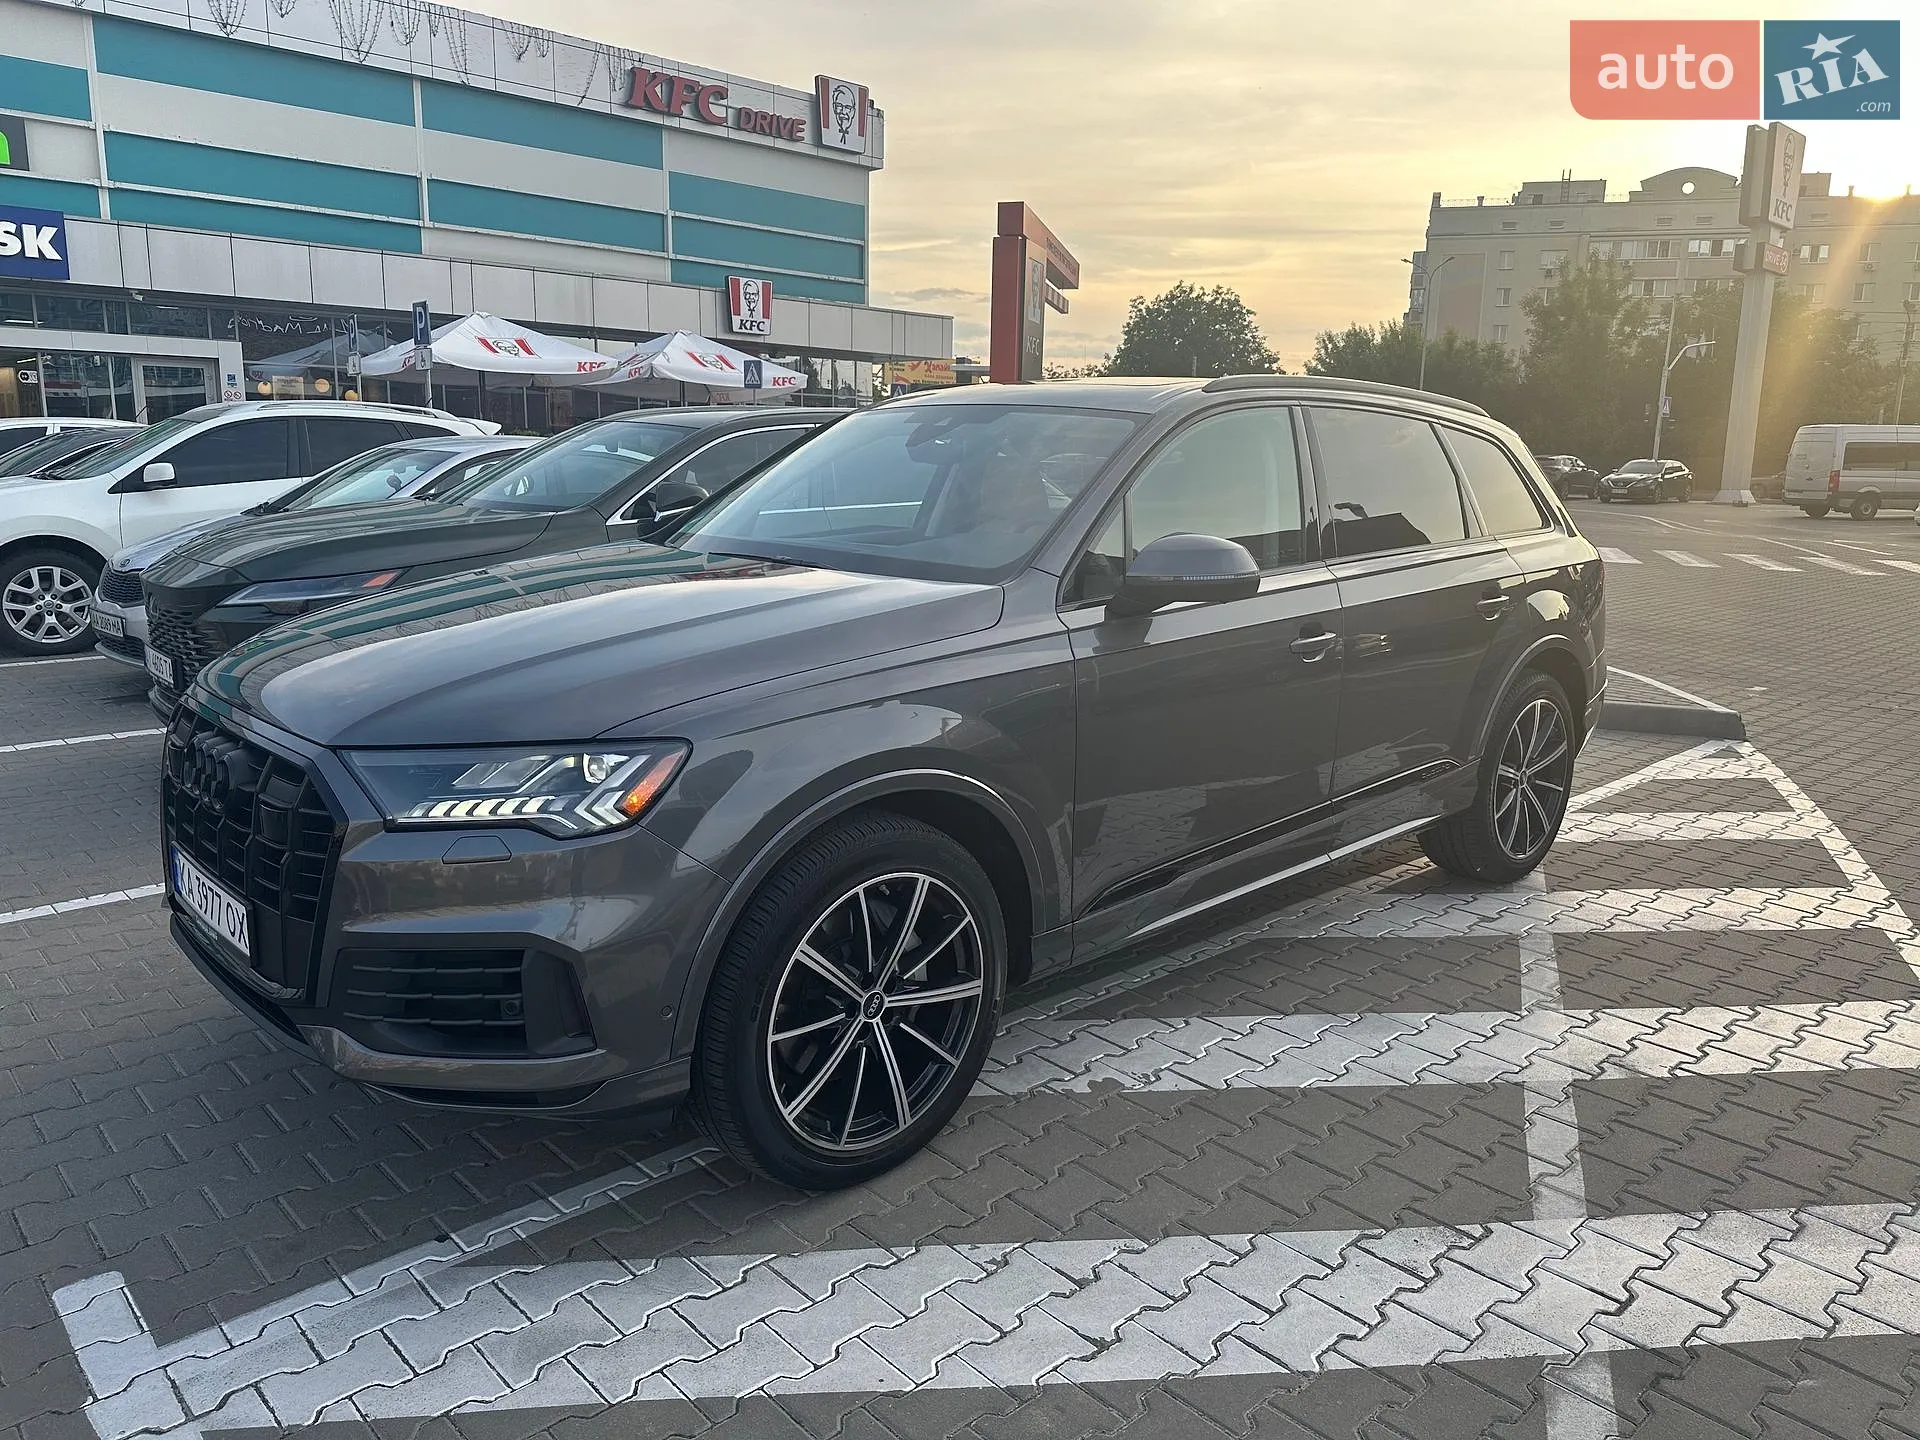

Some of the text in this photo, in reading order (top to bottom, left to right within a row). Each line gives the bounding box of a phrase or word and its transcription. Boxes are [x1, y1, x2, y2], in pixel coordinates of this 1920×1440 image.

[628, 67, 806, 142] KFC DRIVE
[1773, 199, 1792, 222] KFC
[416, 306, 425, 341] P
[738, 319, 765, 332] KFC
[1026, 335, 1040, 356] KFC
[628, 366, 643, 378] KFC
[772, 376, 796, 387] KFC
[178, 857, 195, 903] KA
[195, 874, 221, 926] 3977
[226, 901, 248, 949] OX
